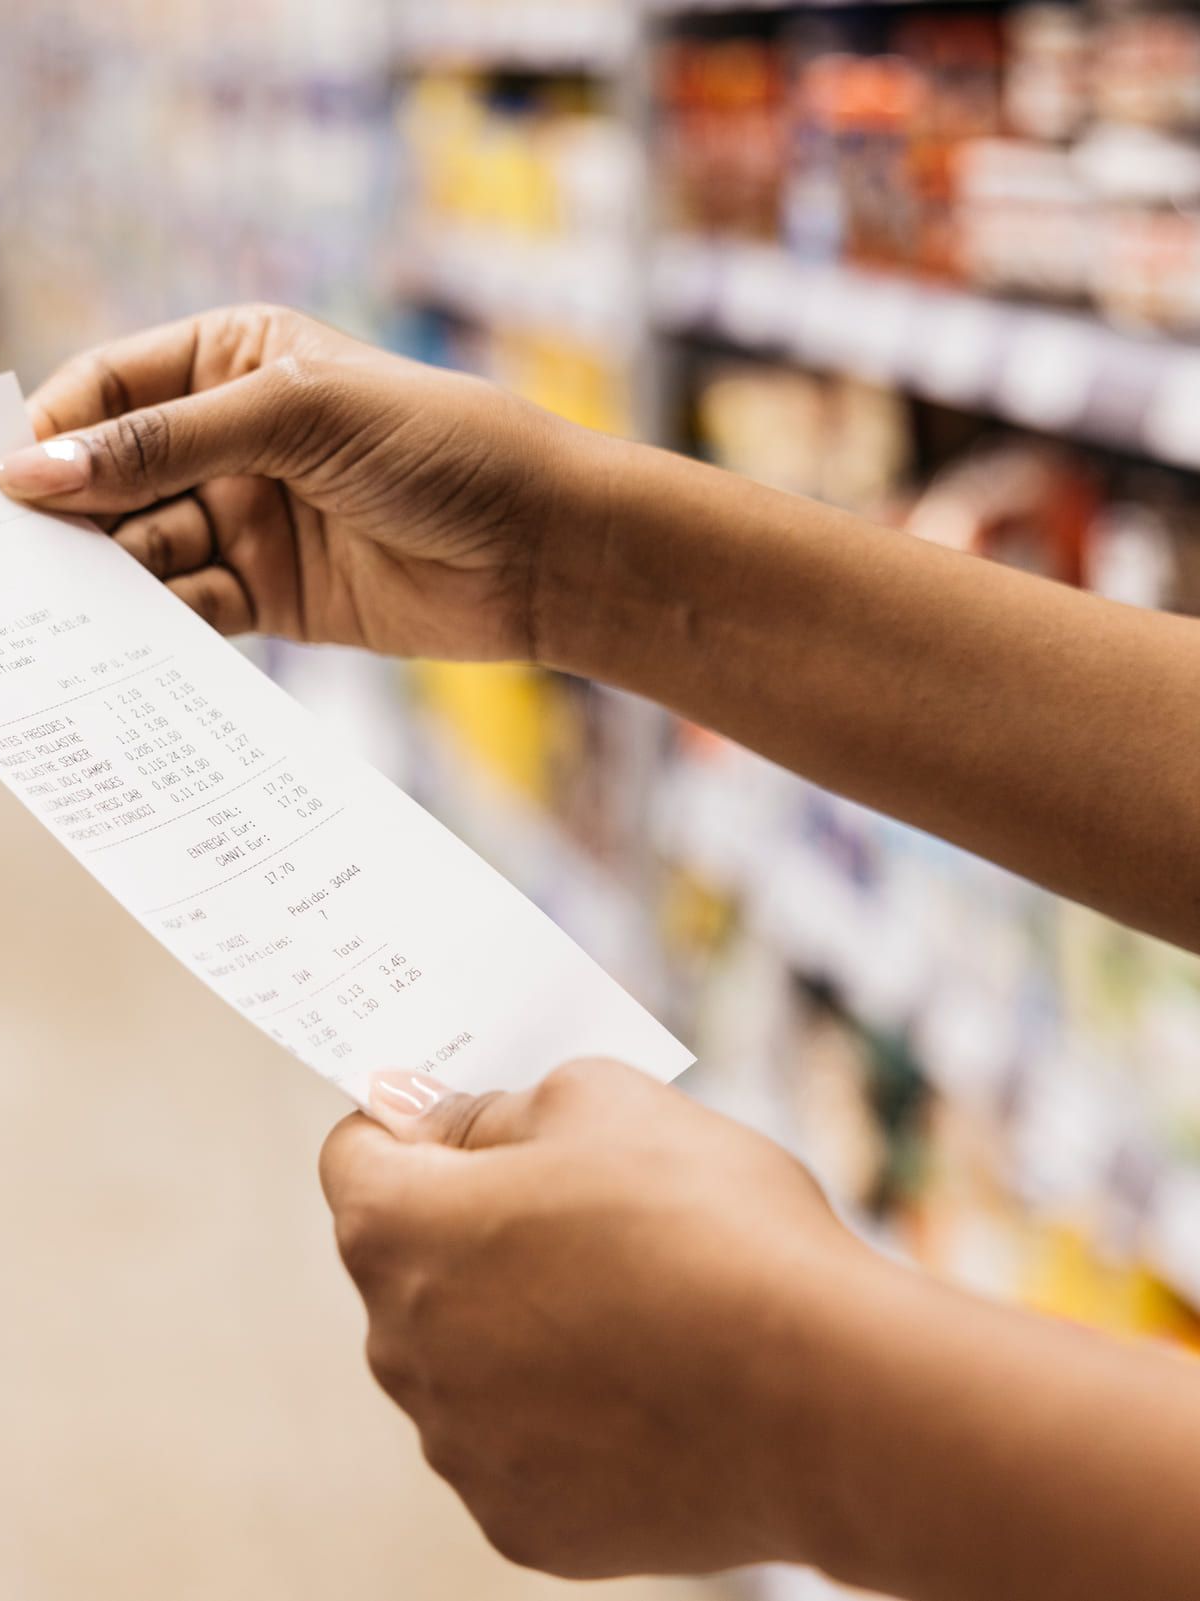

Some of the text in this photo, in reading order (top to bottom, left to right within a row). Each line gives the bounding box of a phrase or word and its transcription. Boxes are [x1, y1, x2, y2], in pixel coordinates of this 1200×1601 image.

[22, 719, 66, 742] FREGIDES
[65, 715, 76, 727] A
[104, 700, 113, 711] 1
[35, 732, 84, 756] POLLASTRE
[116, 714, 127, 724] 1
[58, 748, 94, 768] SENCER
[94, 797, 123, 815] FRESC
[122, 788, 143, 803] CAB
[207, 806, 242, 828] TOTAL:
[186, 831, 231, 859] ENTREGAT
[230, 820, 256, 837] Eur:
[215, 845, 246, 867] CANVI
[244, 834, 271, 851] Eur:
[288, 888, 329, 917] Pedido:
[329, 864, 361, 889] 34044
[318, 909, 328, 921] 7
[333, 935, 365, 958] Total
[435, 1031, 474, 1062] COMPRA
